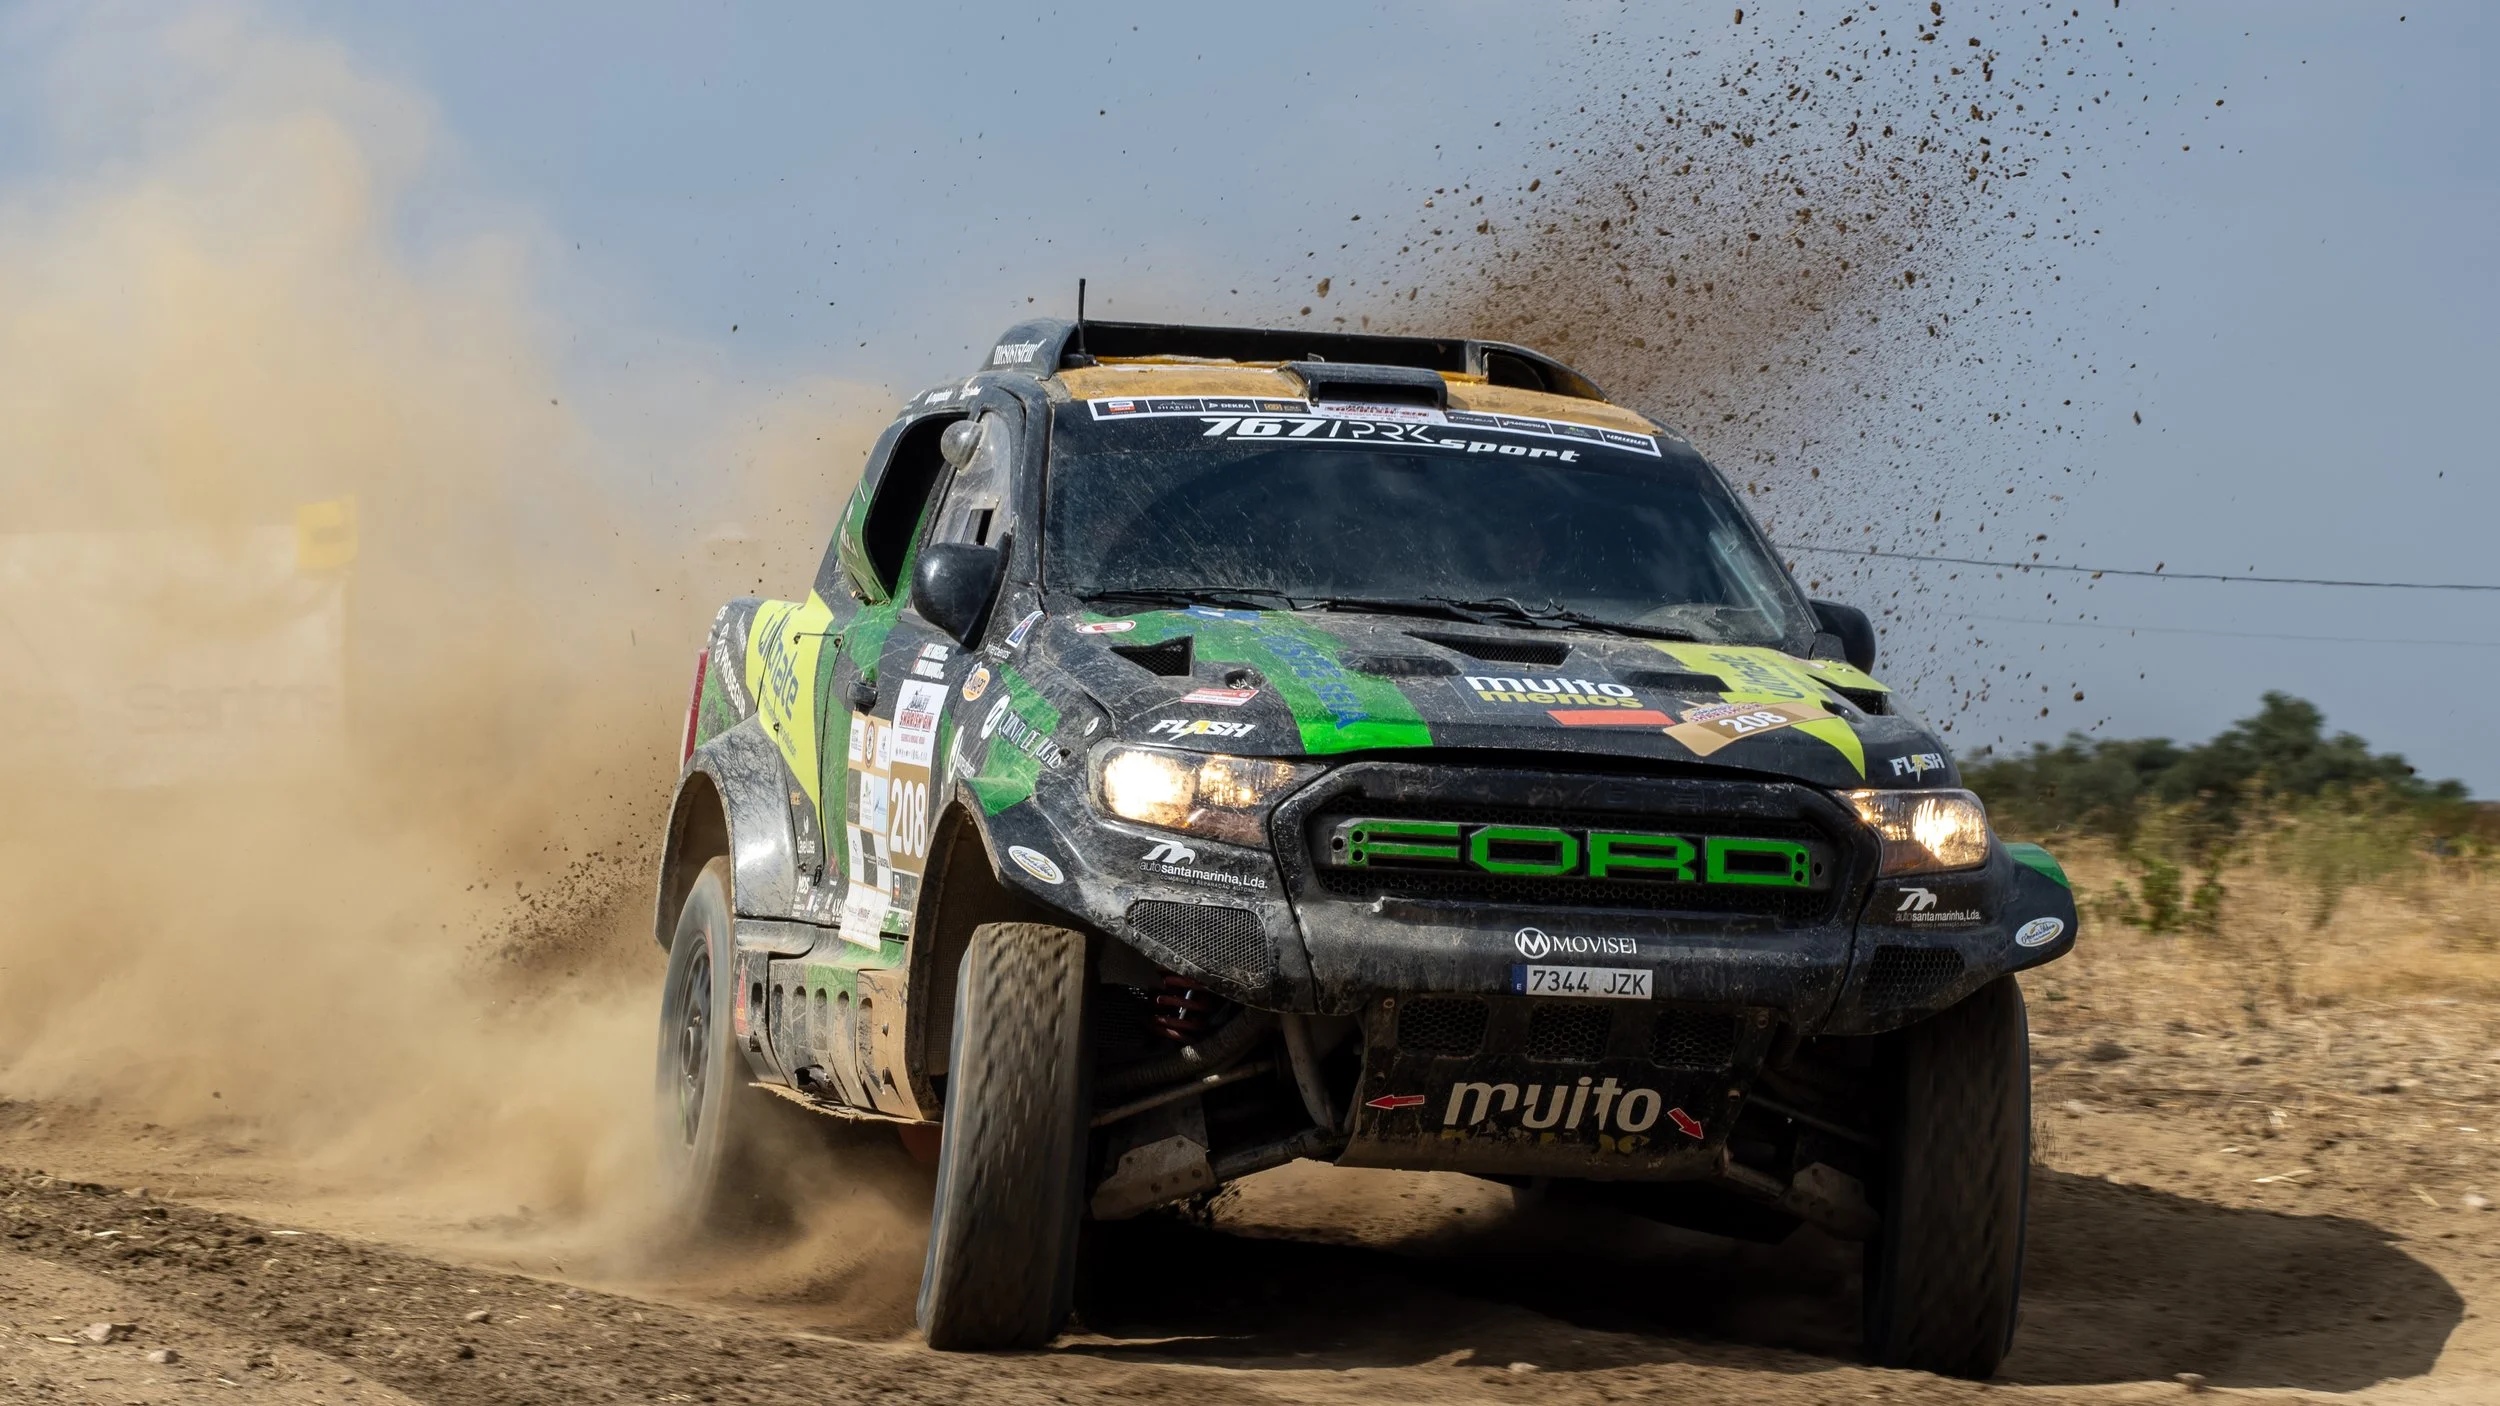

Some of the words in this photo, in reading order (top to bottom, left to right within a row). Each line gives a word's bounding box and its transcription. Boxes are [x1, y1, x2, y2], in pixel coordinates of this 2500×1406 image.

[1220, 402, 1251, 410] DEKRA
[1199, 417, 1327, 437] 767
[1439, 438, 1581, 463] sport
[1464, 676, 1635, 699] muito
[1478, 690, 1645, 711] menos
[1149, 718, 1256, 741] FLASH
[1718, 711, 1788, 734] 208
[1889, 752, 1946, 783] FLASH
[889, 777, 926, 860] 208
[1335, 817, 1812, 888] FORD
[1553, 936, 1638, 955] MOVISEI
[1532, 969, 1590, 993] 7344
[1603, 971, 1648, 996] JZK
[1442, 1076, 1662, 1133] muito
